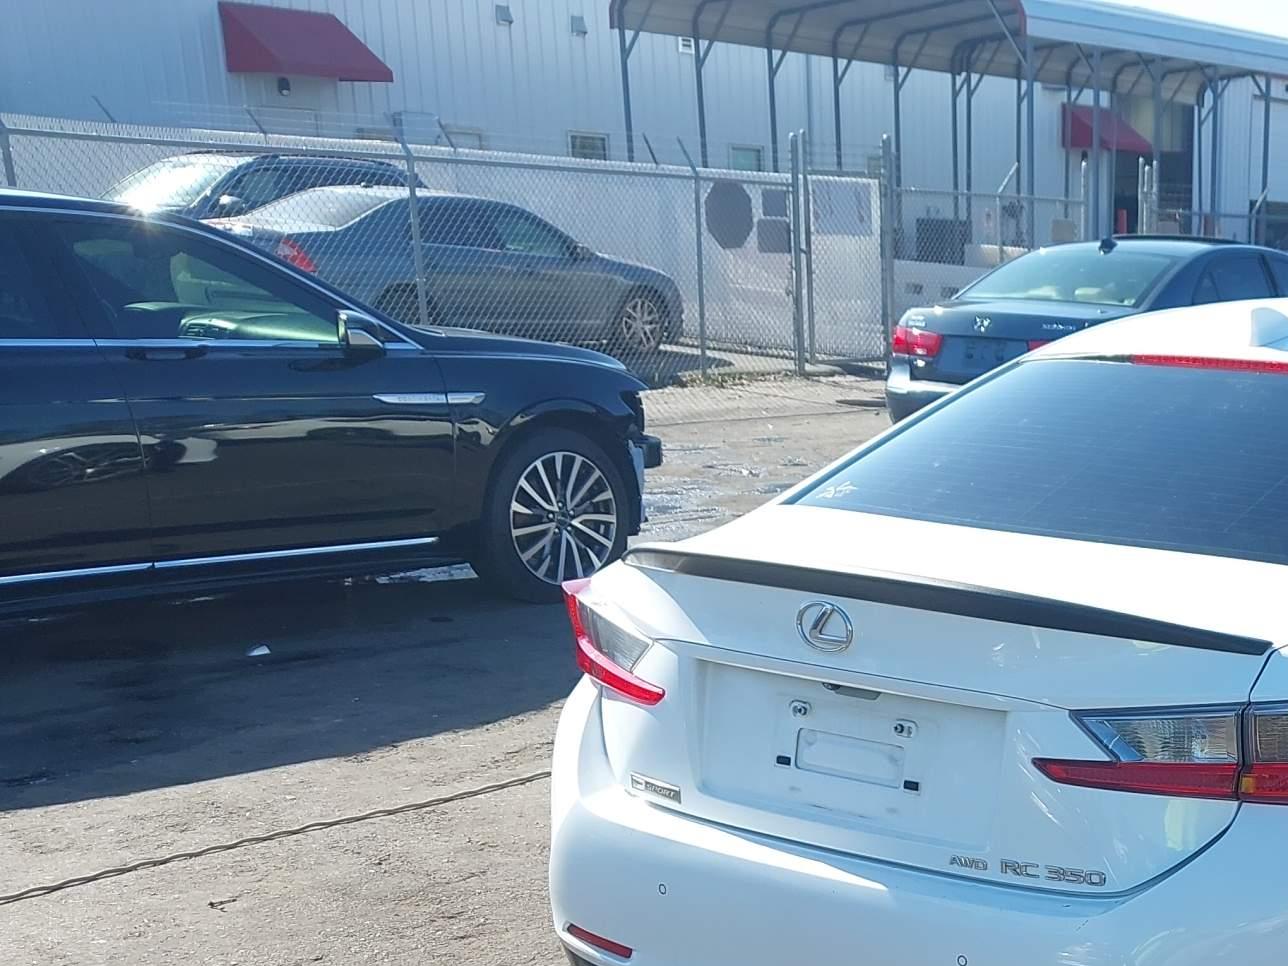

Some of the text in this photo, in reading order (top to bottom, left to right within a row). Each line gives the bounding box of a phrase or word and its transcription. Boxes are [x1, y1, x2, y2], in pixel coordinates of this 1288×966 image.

[949, 854, 1107, 887] AWD RC 350
